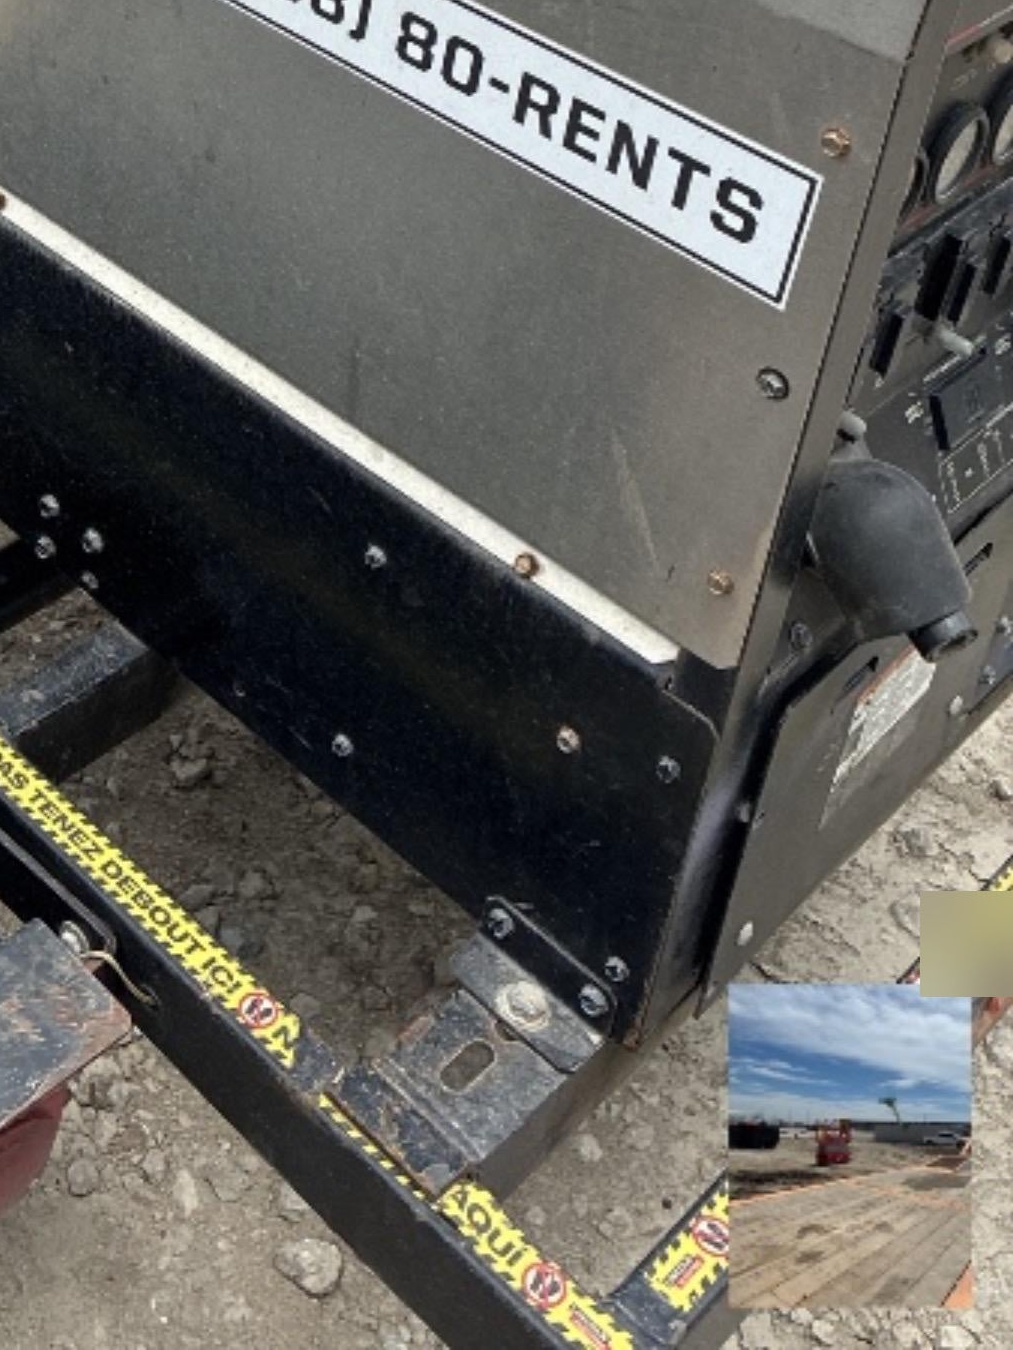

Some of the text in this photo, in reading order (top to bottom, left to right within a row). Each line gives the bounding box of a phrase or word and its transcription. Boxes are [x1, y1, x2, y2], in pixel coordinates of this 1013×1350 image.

[395, 12, 765, 245] 80-RENTS
[28, 788, 105, 860] TENEZ
[101, 860, 207, 954] DEBOUT
[202, 956, 243, 994] ICI
